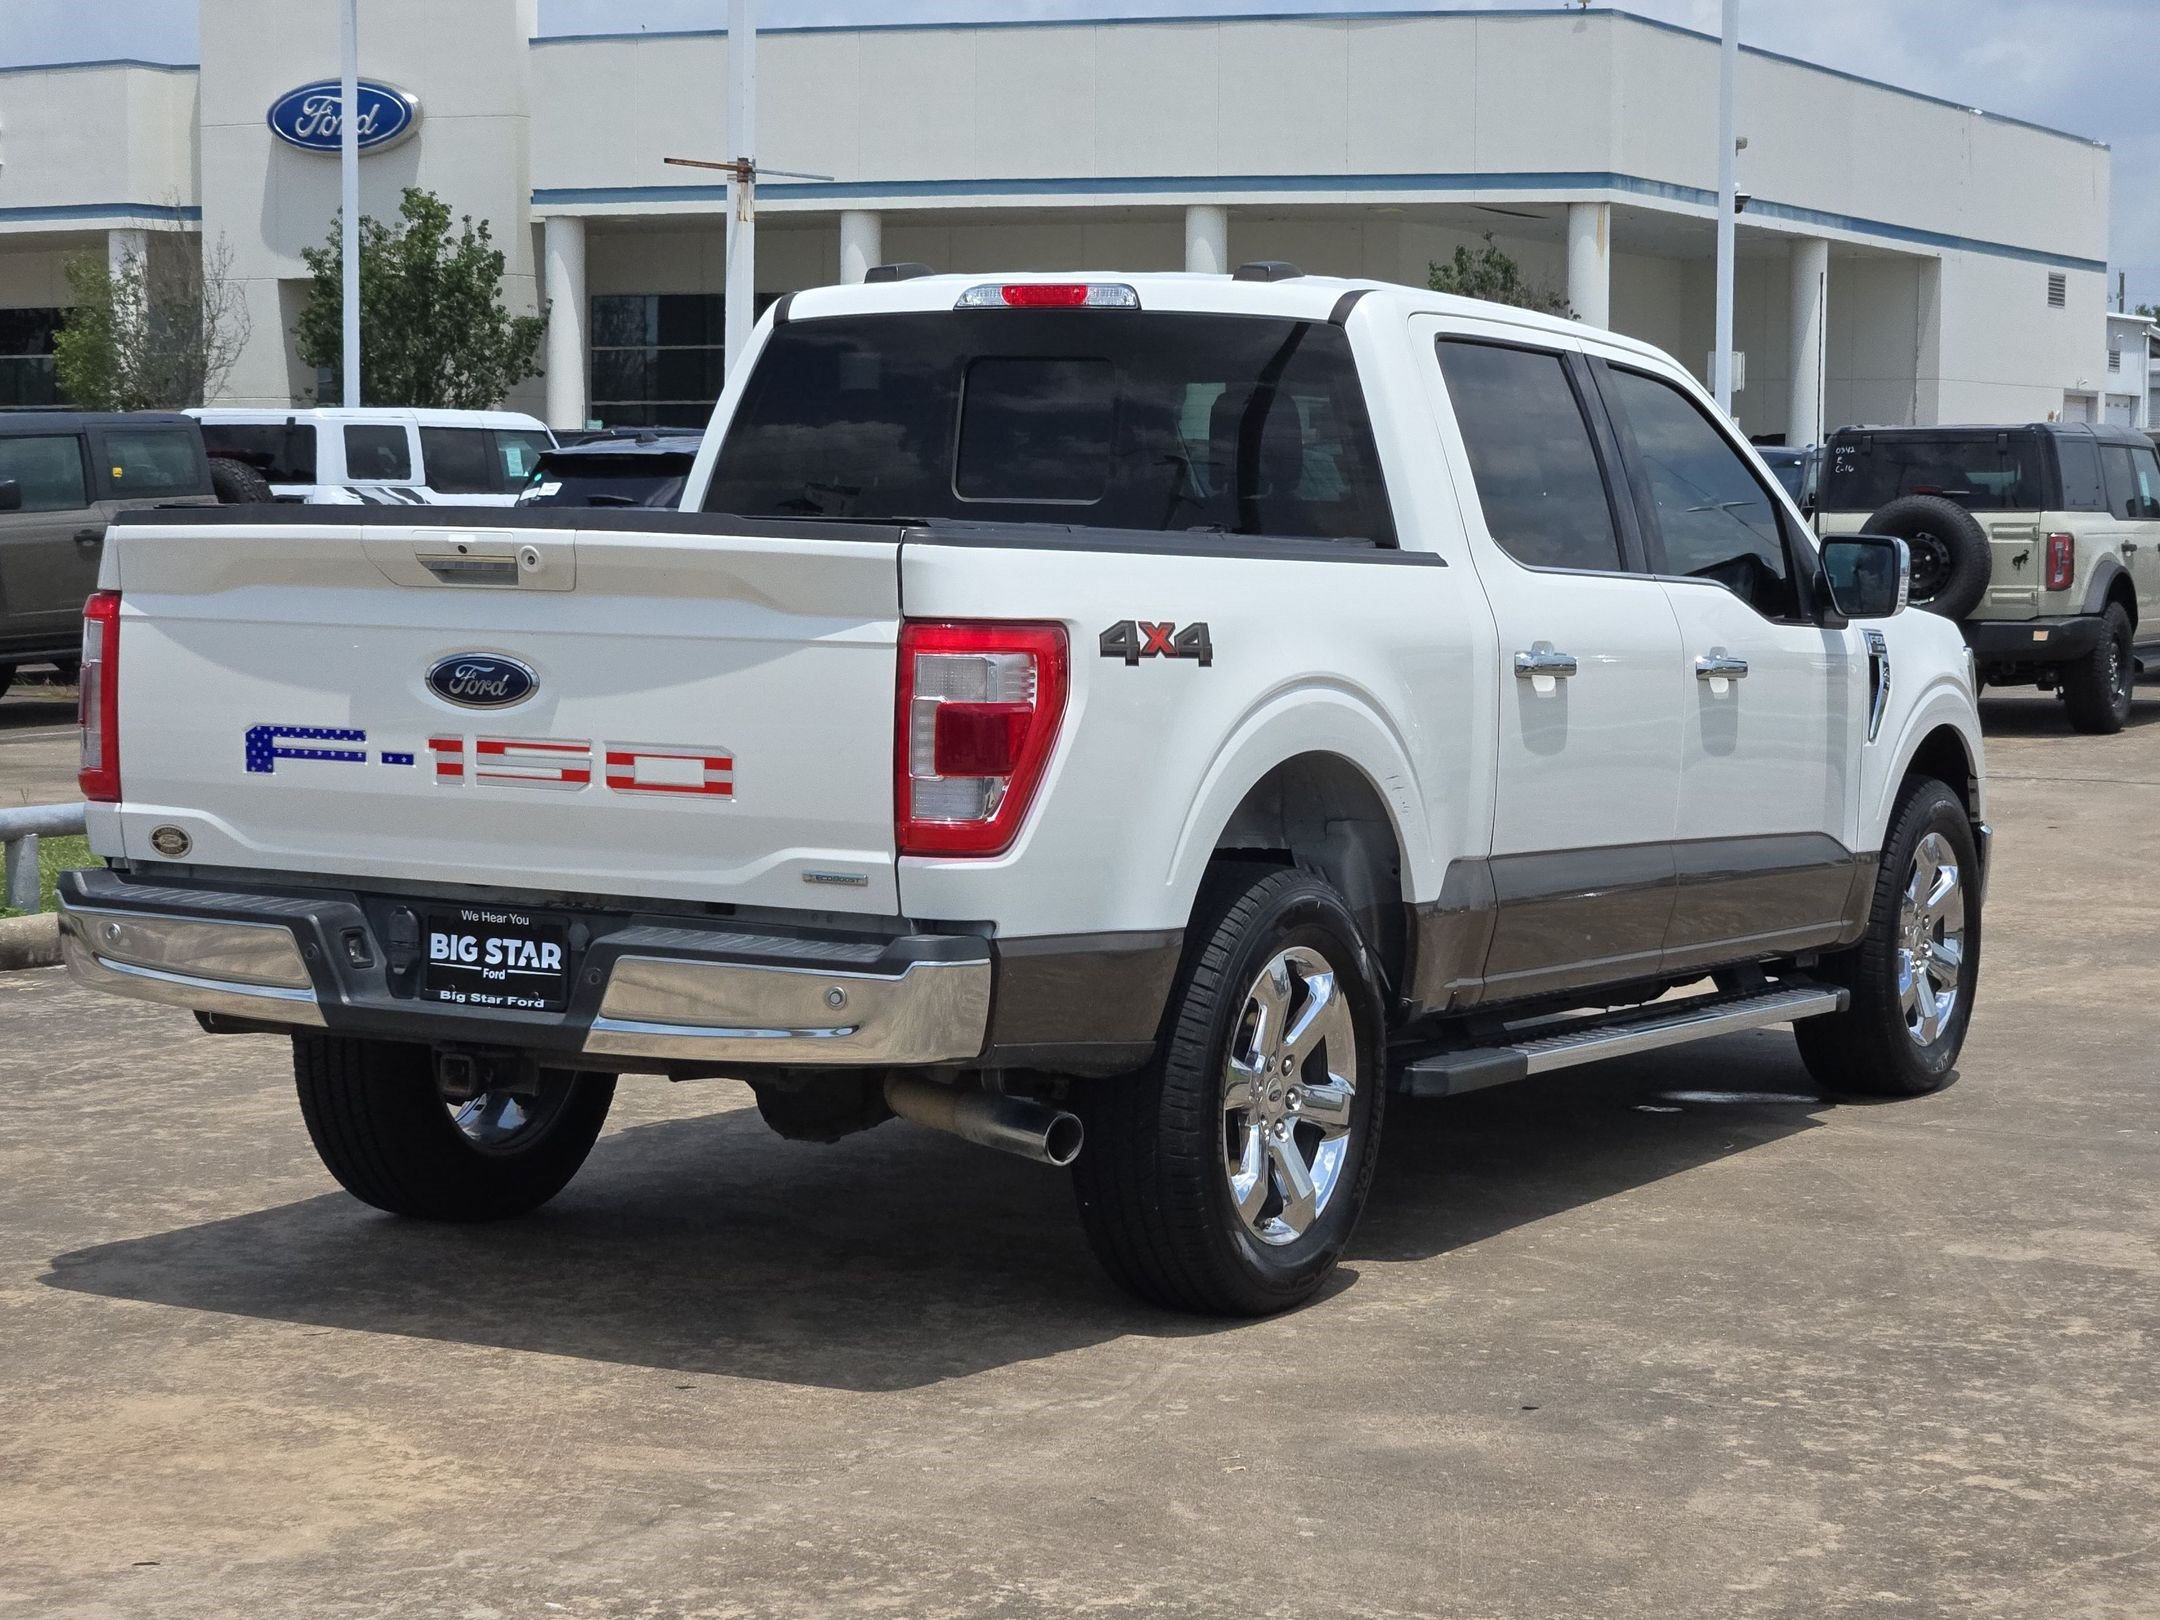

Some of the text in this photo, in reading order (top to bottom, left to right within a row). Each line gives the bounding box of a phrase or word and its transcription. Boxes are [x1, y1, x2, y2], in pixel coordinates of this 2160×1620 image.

[295, 95, 380, 138] Fod
[449, 664, 510, 696] Ford
[244, 725, 736, 800] F-150
[461, 910, 530, 925] We Hear You
[430, 932, 562, 970] BIG STAR
[483, 968, 506, 980] Ford
[440, 990, 545, 1008] Big Star Ford
